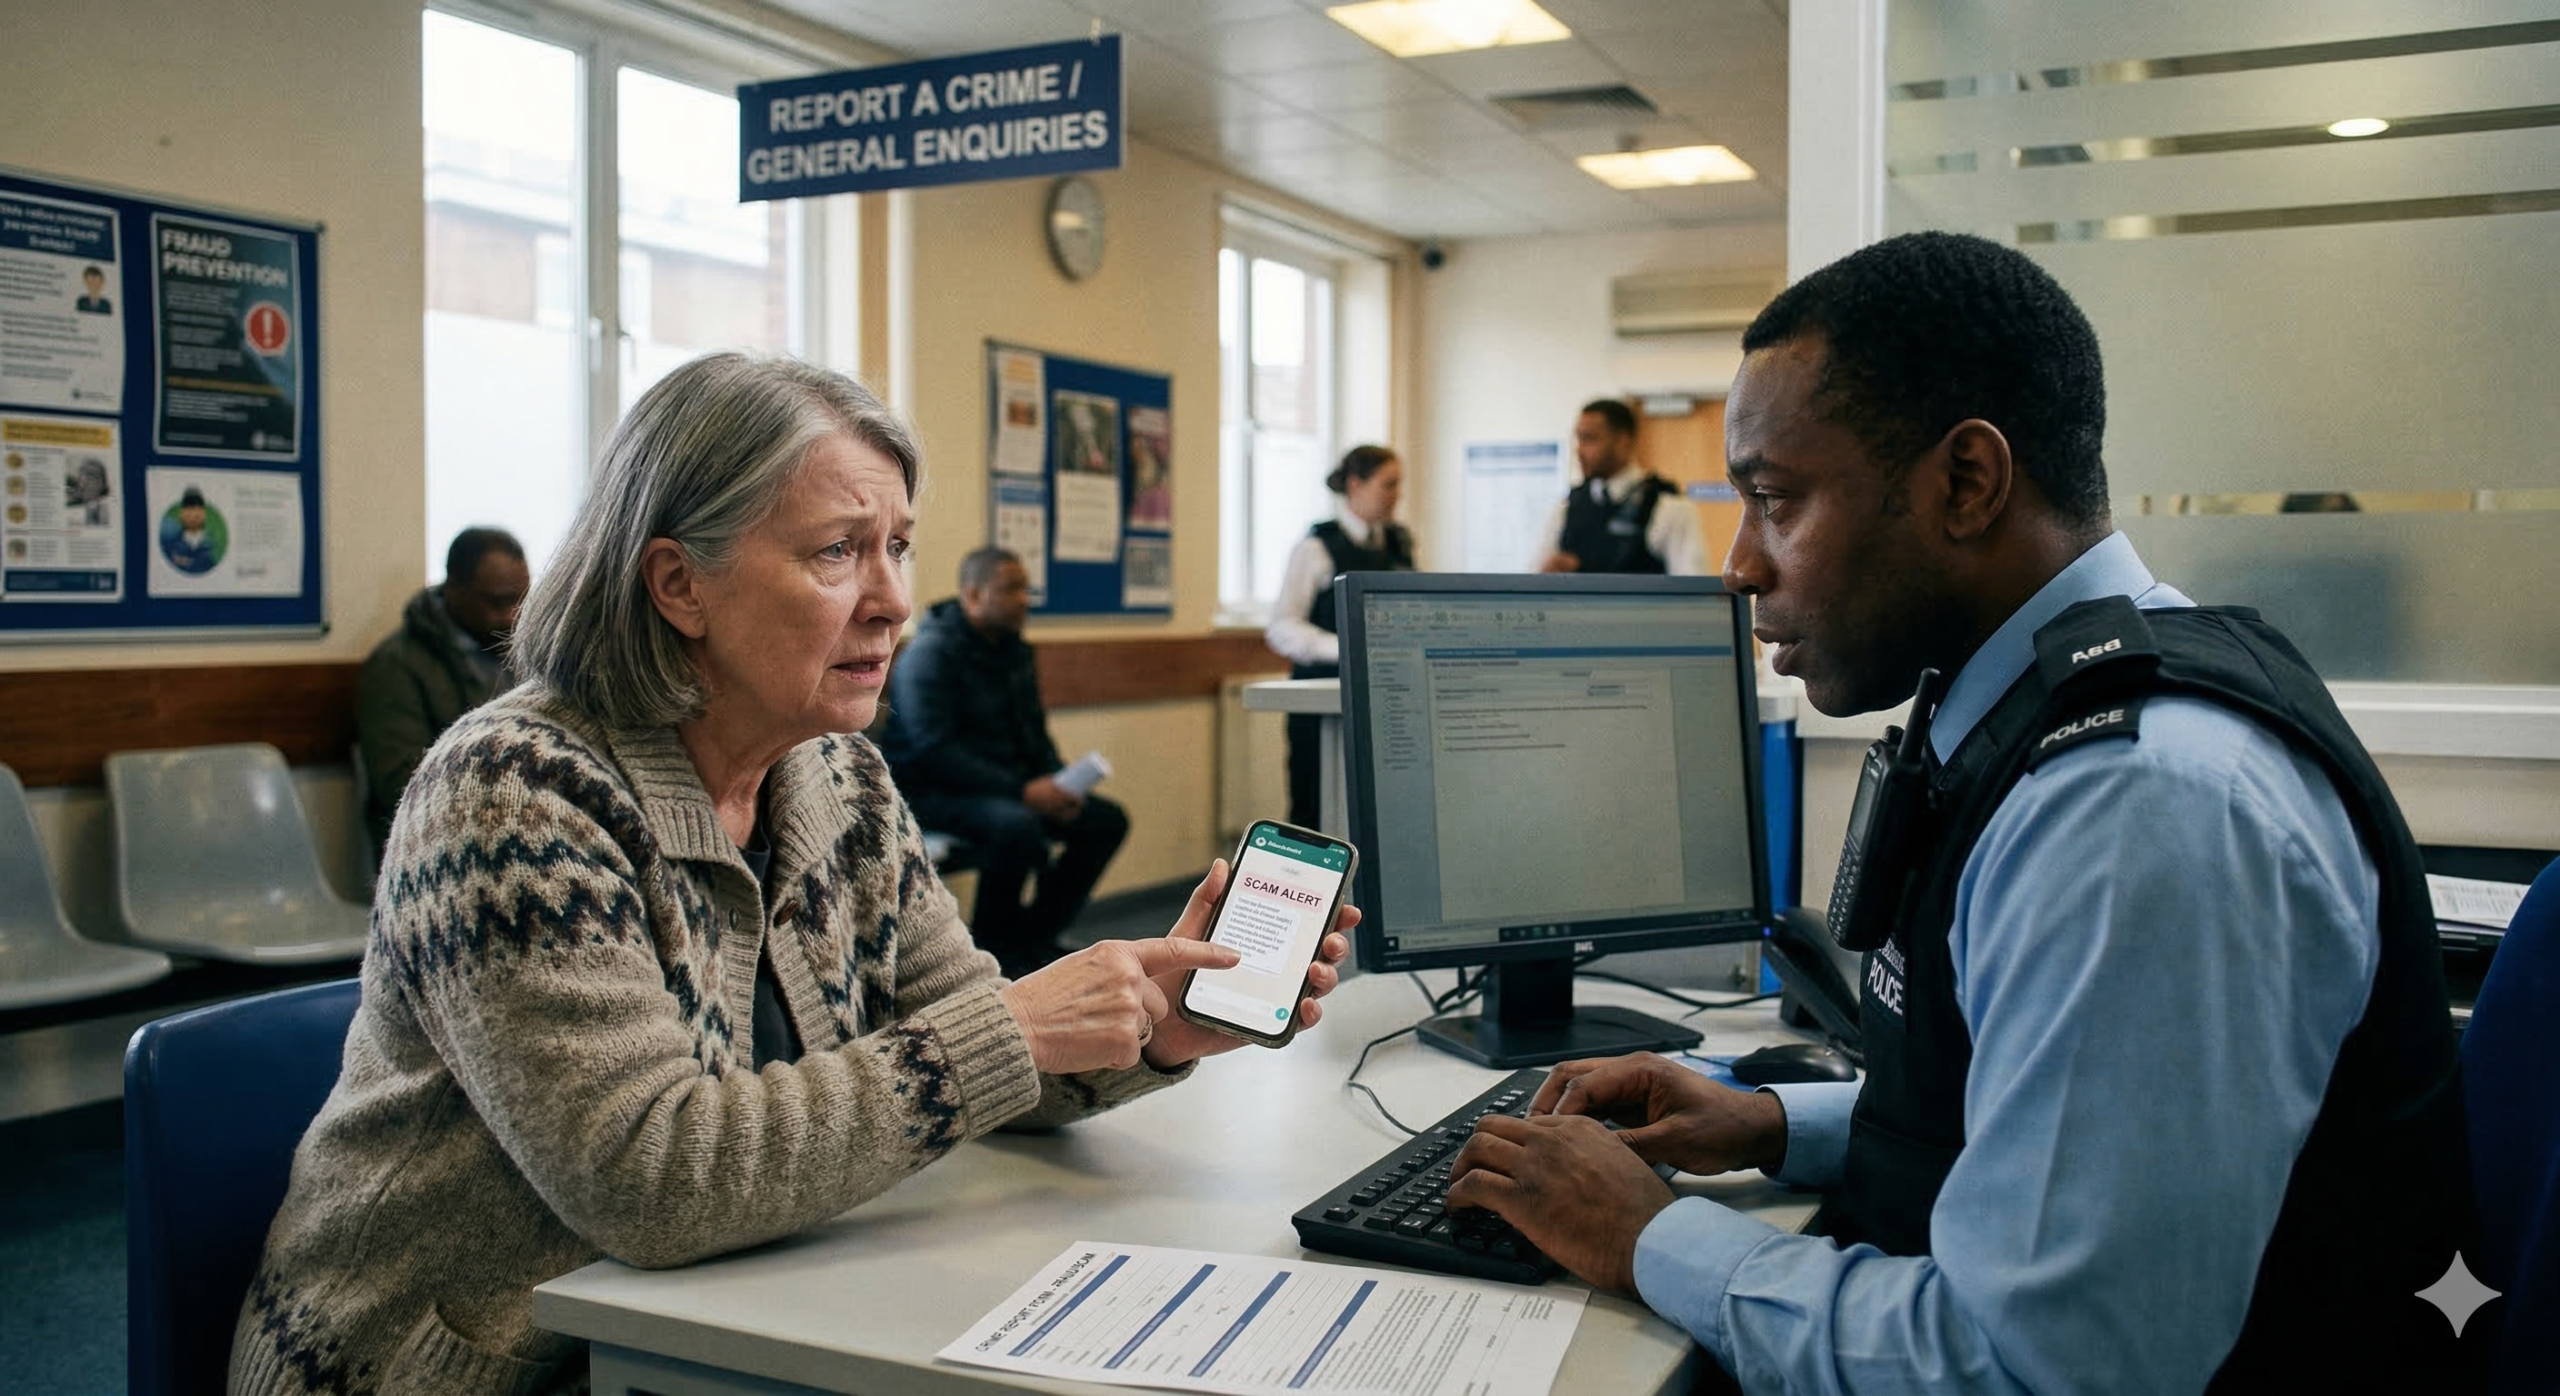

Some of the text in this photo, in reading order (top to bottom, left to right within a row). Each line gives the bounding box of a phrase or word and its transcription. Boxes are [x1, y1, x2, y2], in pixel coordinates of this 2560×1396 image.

[769, 60, 1083, 134] REPORT A CRIME /
[747, 109, 1109, 185] GENERAL ENQUIRIES
[161, 228, 232, 259] FRAUD
[162, 251, 288, 289] PREVENTION
[2040, 709, 2125, 748] POLICE
[1244, 876, 1322, 907] SCAM ALERT
[1867, 957, 1904, 1016] POLICE
